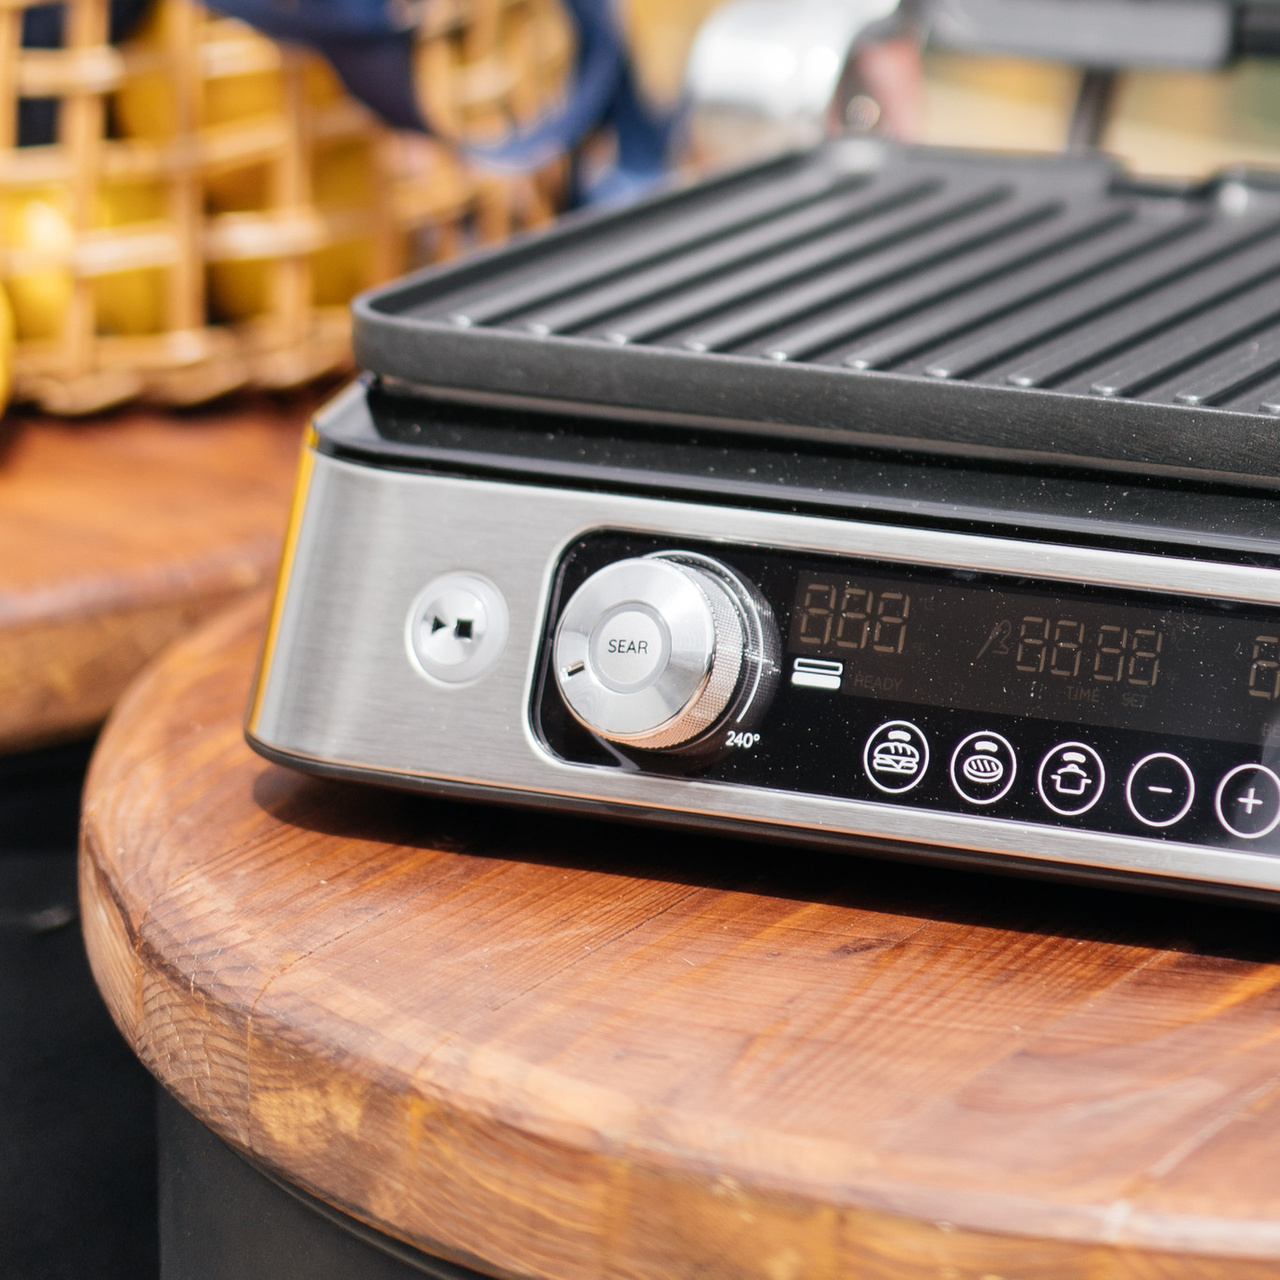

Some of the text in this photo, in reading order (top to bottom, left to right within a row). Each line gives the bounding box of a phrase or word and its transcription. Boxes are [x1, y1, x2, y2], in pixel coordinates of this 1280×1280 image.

[608, 639, 648, 654] SEAR
[853, 674, 903, 692] READY
[1066, 685, 1148, 708] TIME SET
